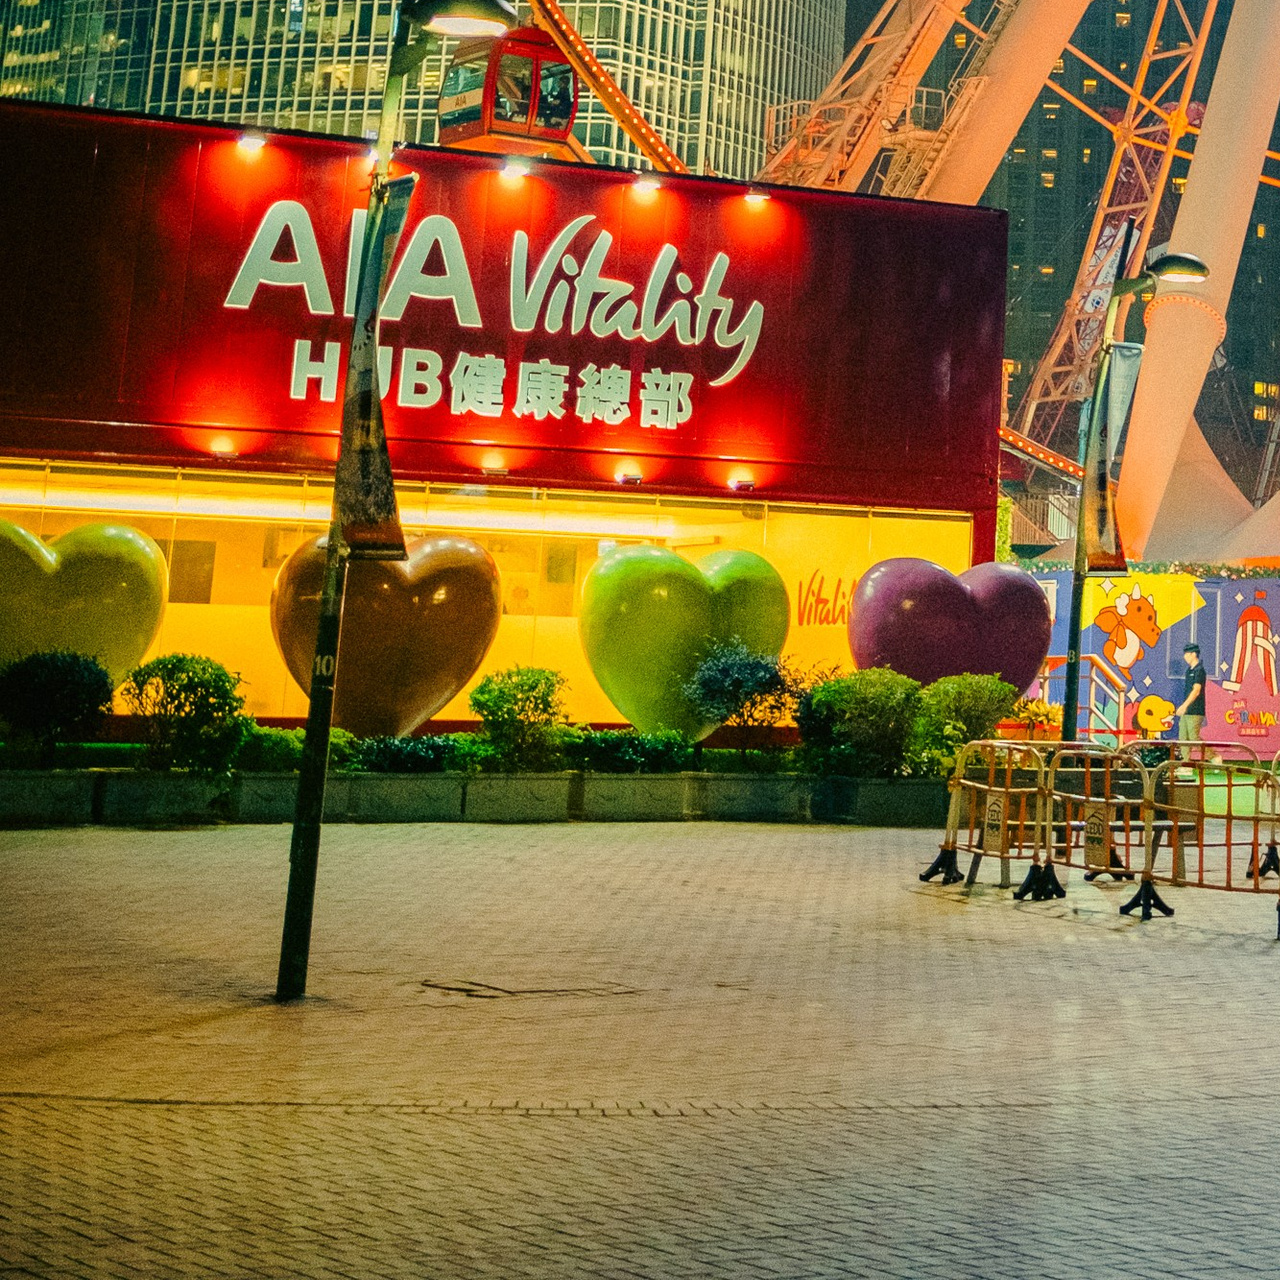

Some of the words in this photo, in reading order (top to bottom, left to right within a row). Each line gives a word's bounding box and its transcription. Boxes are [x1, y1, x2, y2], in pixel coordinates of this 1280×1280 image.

[223, 200, 483, 328] AIA
[510, 214, 765, 387] Vitality
[450, 351, 694, 430] 健康總部
[315, 655, 335, 677] 10
[1225, 709, 1280, 727] CARNIVAL
